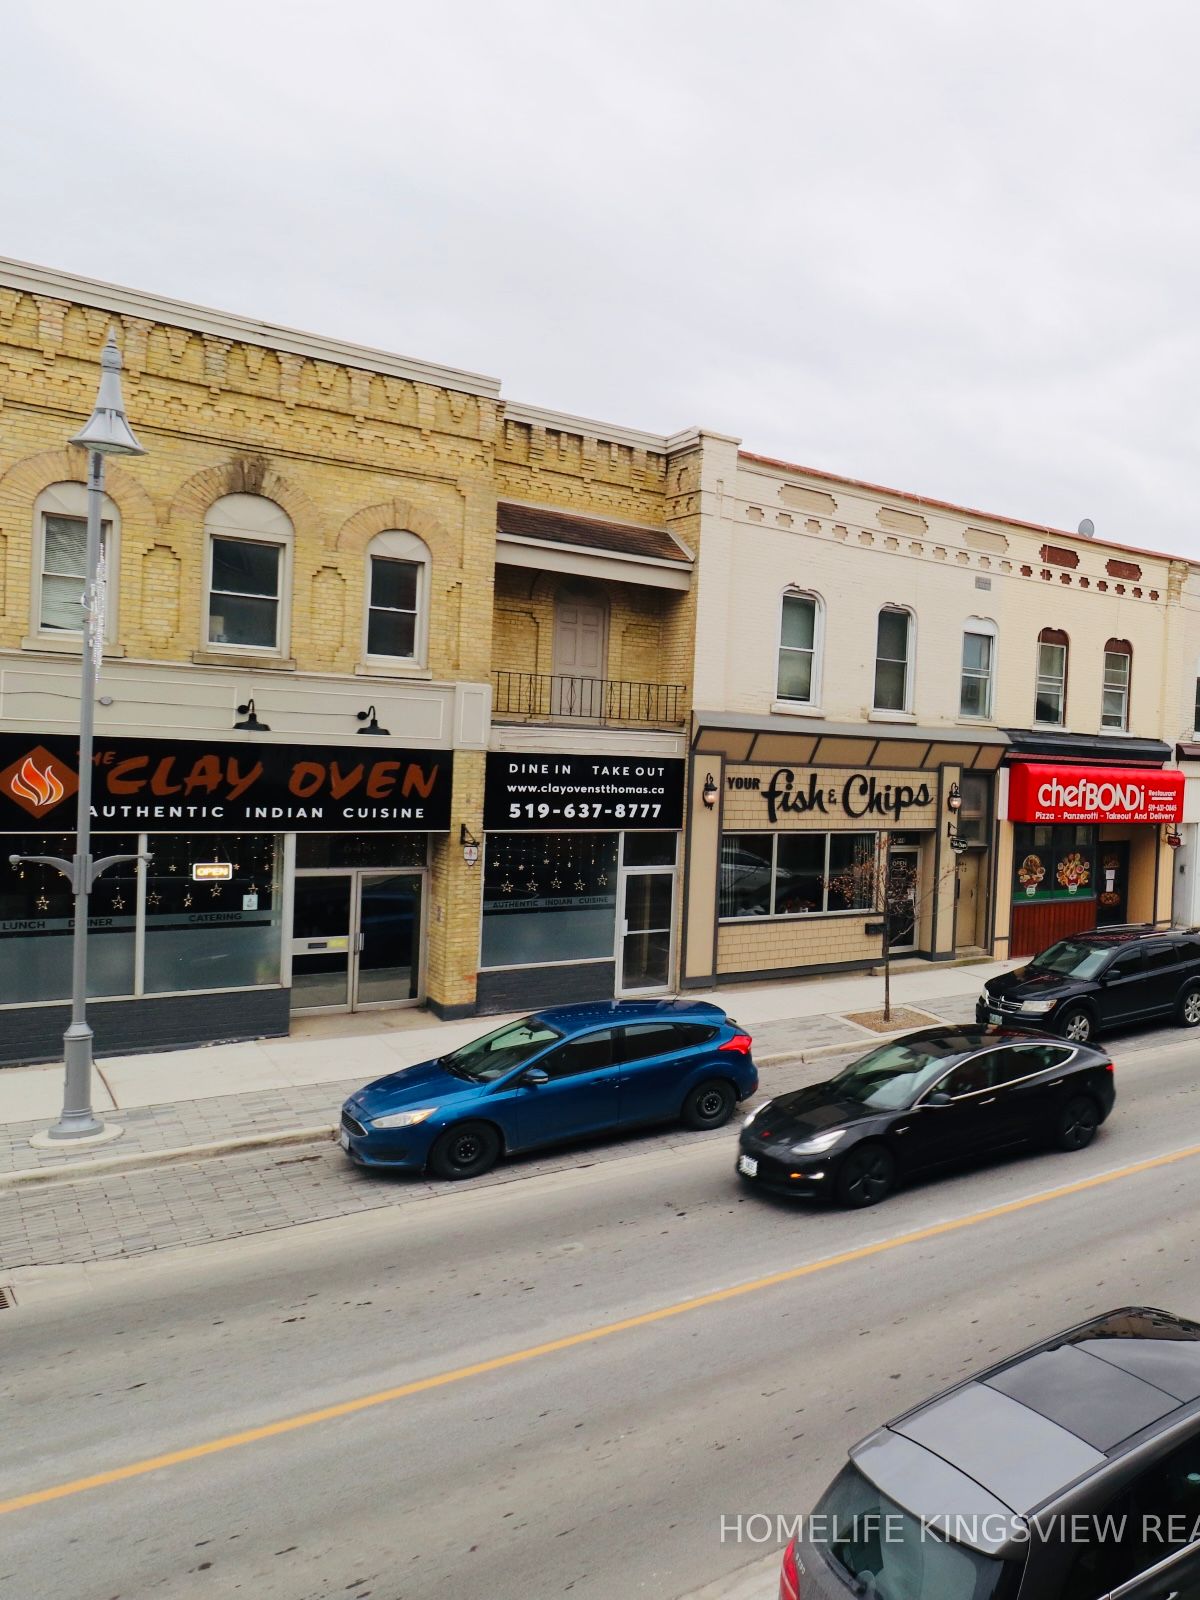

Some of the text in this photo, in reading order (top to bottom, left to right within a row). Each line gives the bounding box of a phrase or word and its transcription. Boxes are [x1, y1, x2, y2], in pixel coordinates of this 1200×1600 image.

[509, 763, 571, 775] DINE IN
[592, 765, 665, 777] TAKE OUT
[77, 751, 439, 801] HE CLAY OVEN
[507, 783, 665, 795] www.clayovenstthomas.ca
[1037, 777, 1145, 812] chefBONDi
[727, 776, 761, 791] YOUR
[842, 773, 934, 823] Chips
[89, 805, 425, 818] AUTHENTIC INDIAN CUISINE
[508, 803, 662, 819] 519-637-8777
[1035, 811, 1055, 820] Pizza
[1063, 812, 1099, 820] Panzerotti
[1106, 812, 1131, 820] Takeout
[1134, 812, 1147, 820] And
[1150, 812, 1175, 821] Delivery
[197, 867, 228, 876] OPEN
[493, 896, 609, 909] AUTHENTIC INDIAN CUISINE
[2, 912, 242, 930] LUNCH DNER CATERING
